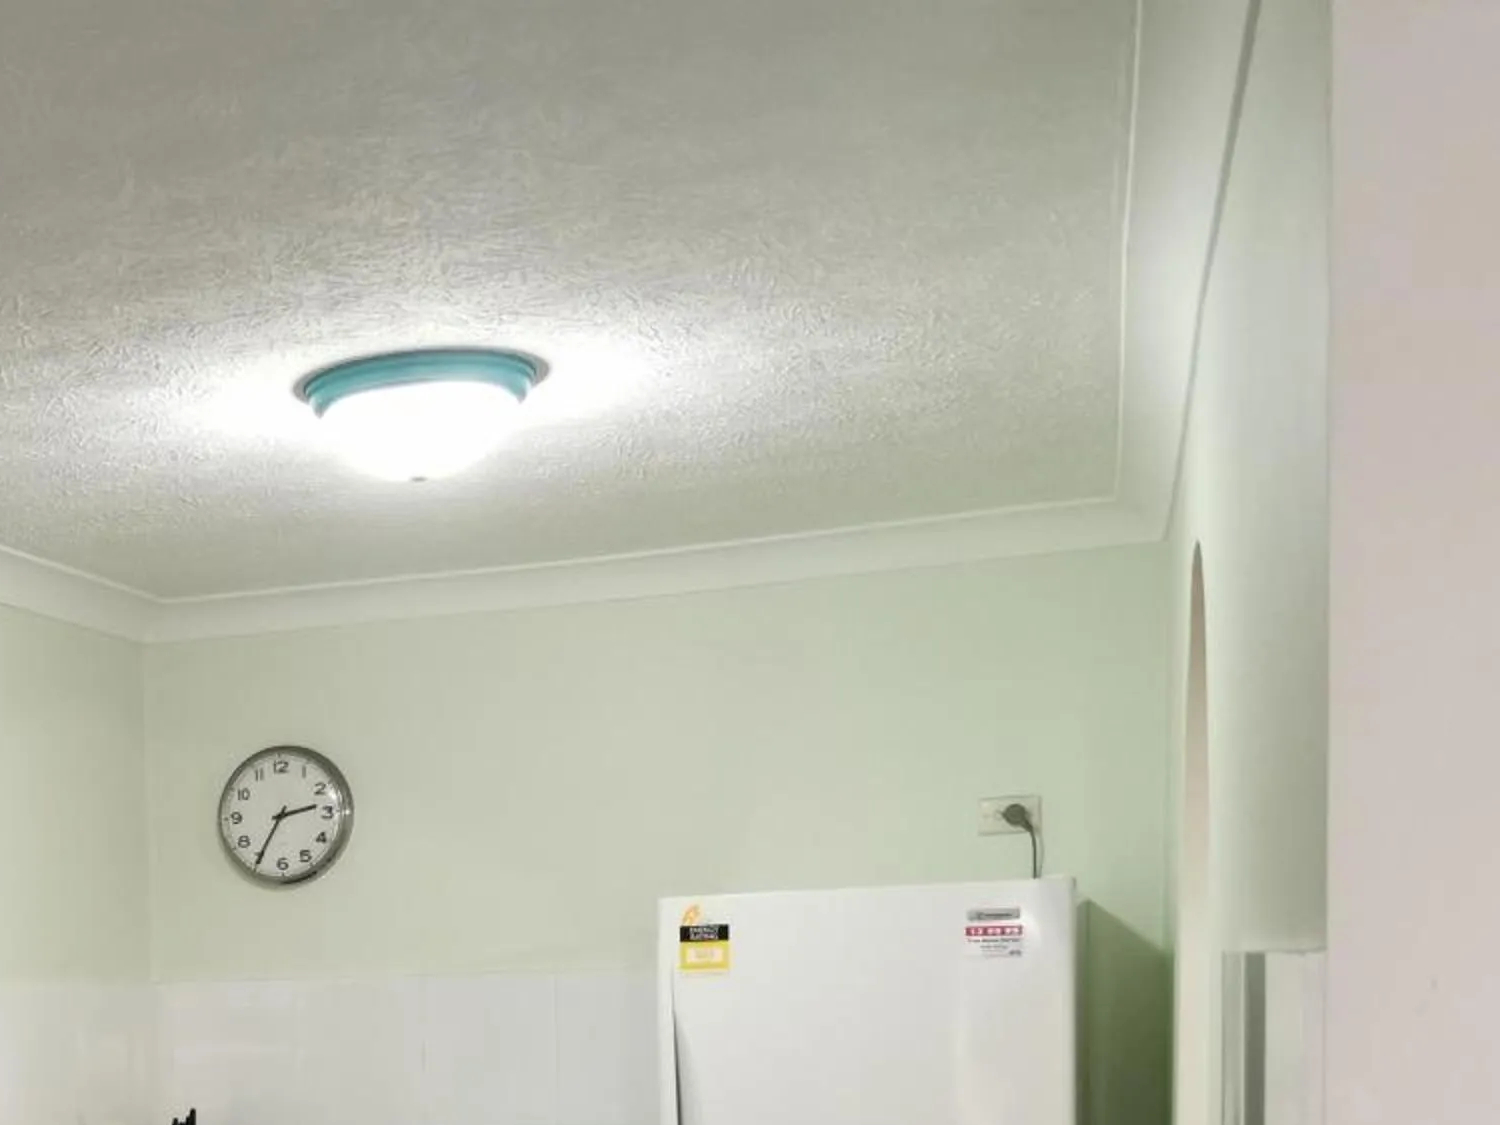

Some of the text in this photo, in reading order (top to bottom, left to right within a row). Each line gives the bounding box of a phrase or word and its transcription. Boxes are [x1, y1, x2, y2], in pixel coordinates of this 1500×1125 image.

[273, 759, 289, 774] 12
[301, 765, 307, 778] 1
[255, 767, 264, 782] 11
[237, 788, 250, 801] 10
[314, 782, 326, 795] 2
[230, 811, 243, 825] 9
[322, 805, 334, 820] 3
[237, 835, 251, 849] 8
[315, 831, 327, 844] 4
[299, 850, 312, 863] 5
[276, 857, 289, 871] 6
